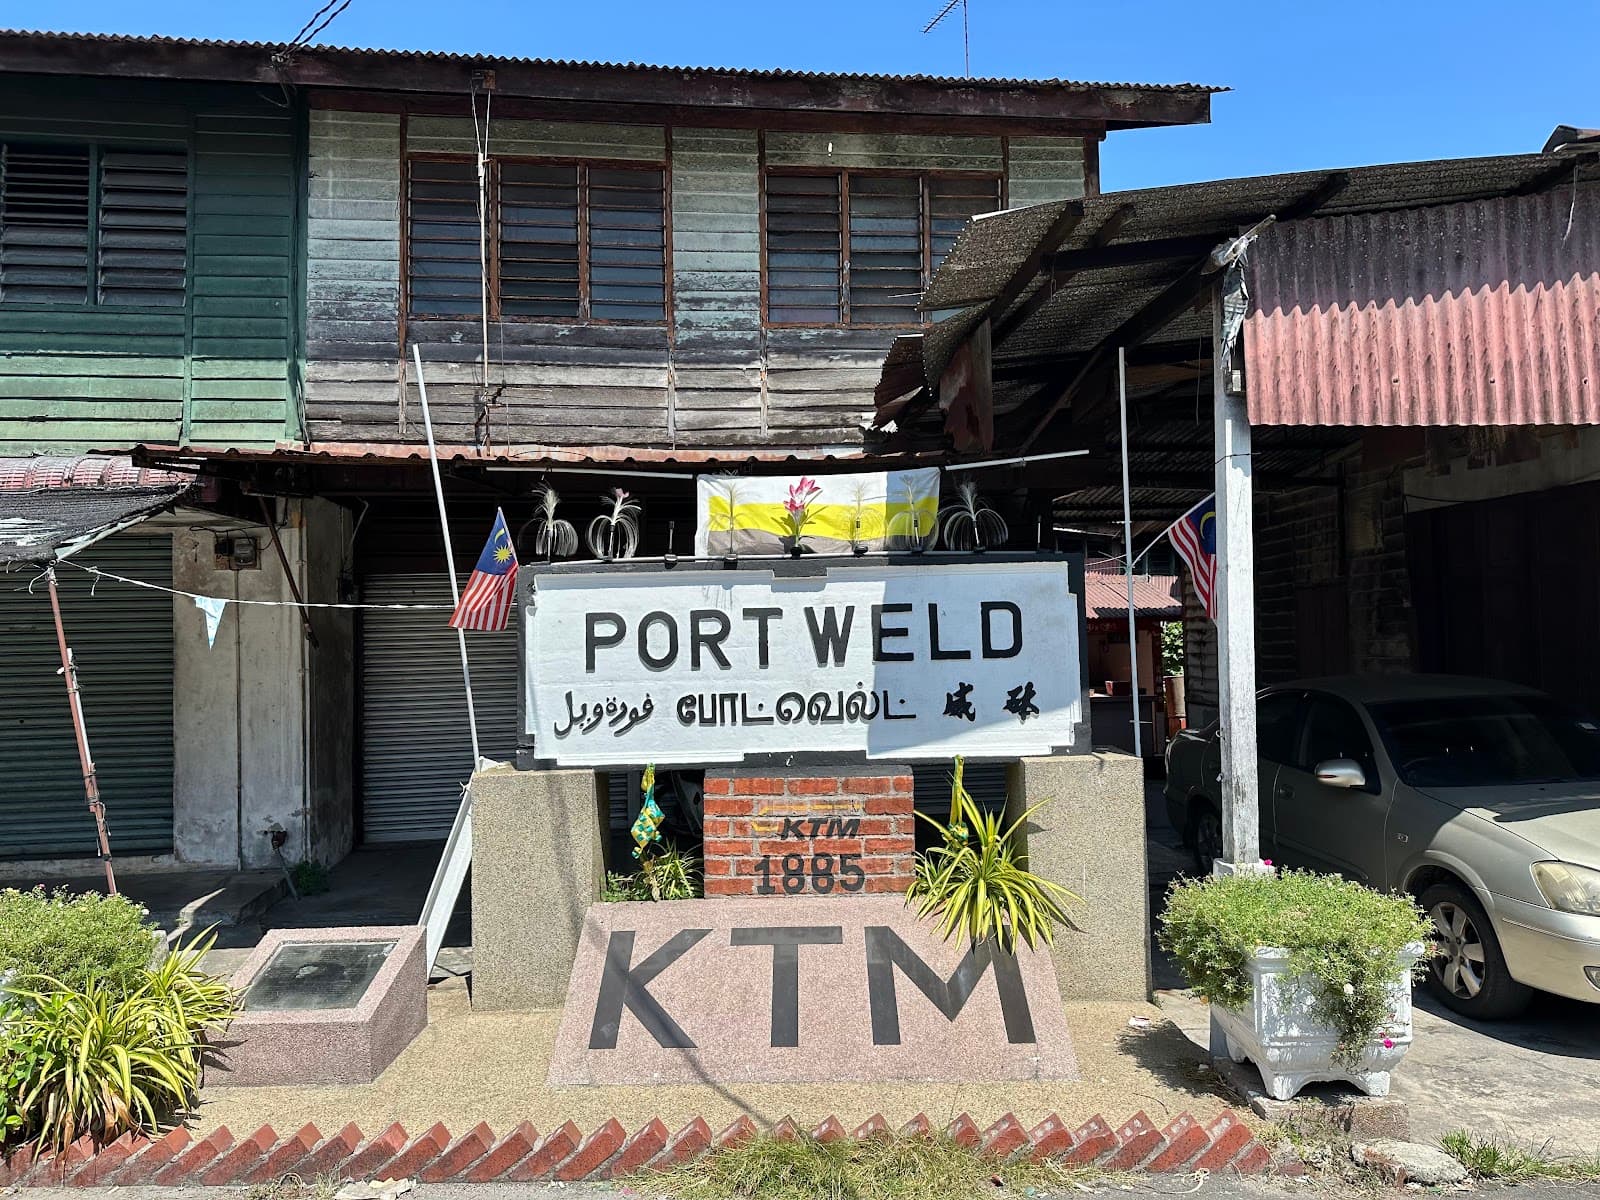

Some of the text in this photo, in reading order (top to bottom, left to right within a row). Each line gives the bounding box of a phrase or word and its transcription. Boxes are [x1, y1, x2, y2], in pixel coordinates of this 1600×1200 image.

[585, 601, 1023, 672] PORT WELD
[780, 817, 861, 840] KTM
[754, 852, 865, 896] 1885
[588, 925, 1036, 1050] KTM
